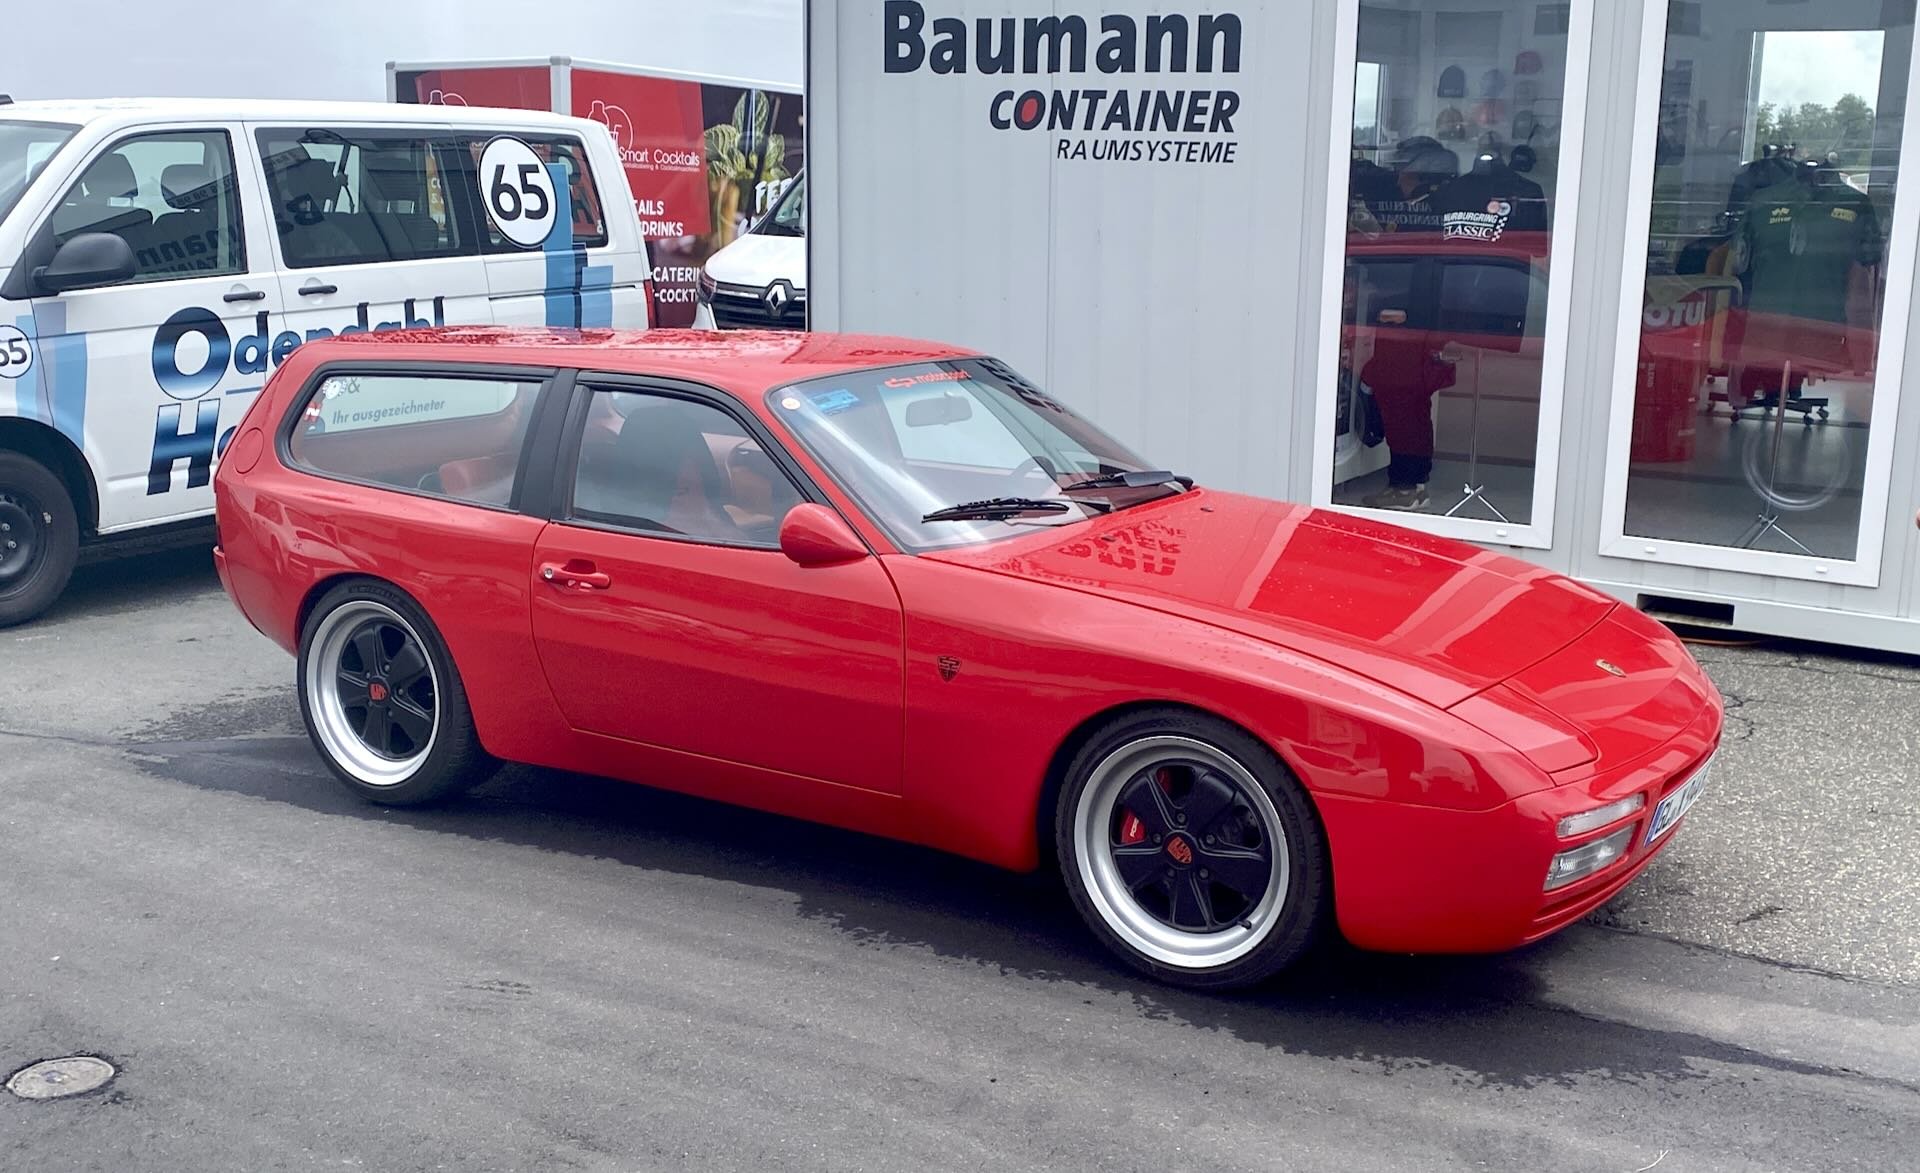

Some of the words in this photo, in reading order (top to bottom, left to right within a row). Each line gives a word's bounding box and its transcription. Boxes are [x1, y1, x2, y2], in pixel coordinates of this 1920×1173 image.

[884, 0, 1242, 74] Baumann
[989, 90, 1240, 133] CONTAINER
[619, 146, 649, 163] Smart
[653, 149, 700, 167] Cocktails
[1056, 139, 1238, 164] RAUMSYSTEME
[490, 163, 549, 222] 65
[642, 220, 684, 237] DRINKS
[1443, 225, 1494, 238] CLASSIC
[652, 287, 698, 303] -COCKT
[1644, 300, 1705, 328] OTU
[152, 296, 445, 400] Odedhl
[332, 410, 349, 425] Ihr
[352, 400, 446, 423] ausgezeichneter
[146, 397, 237, 496] H
